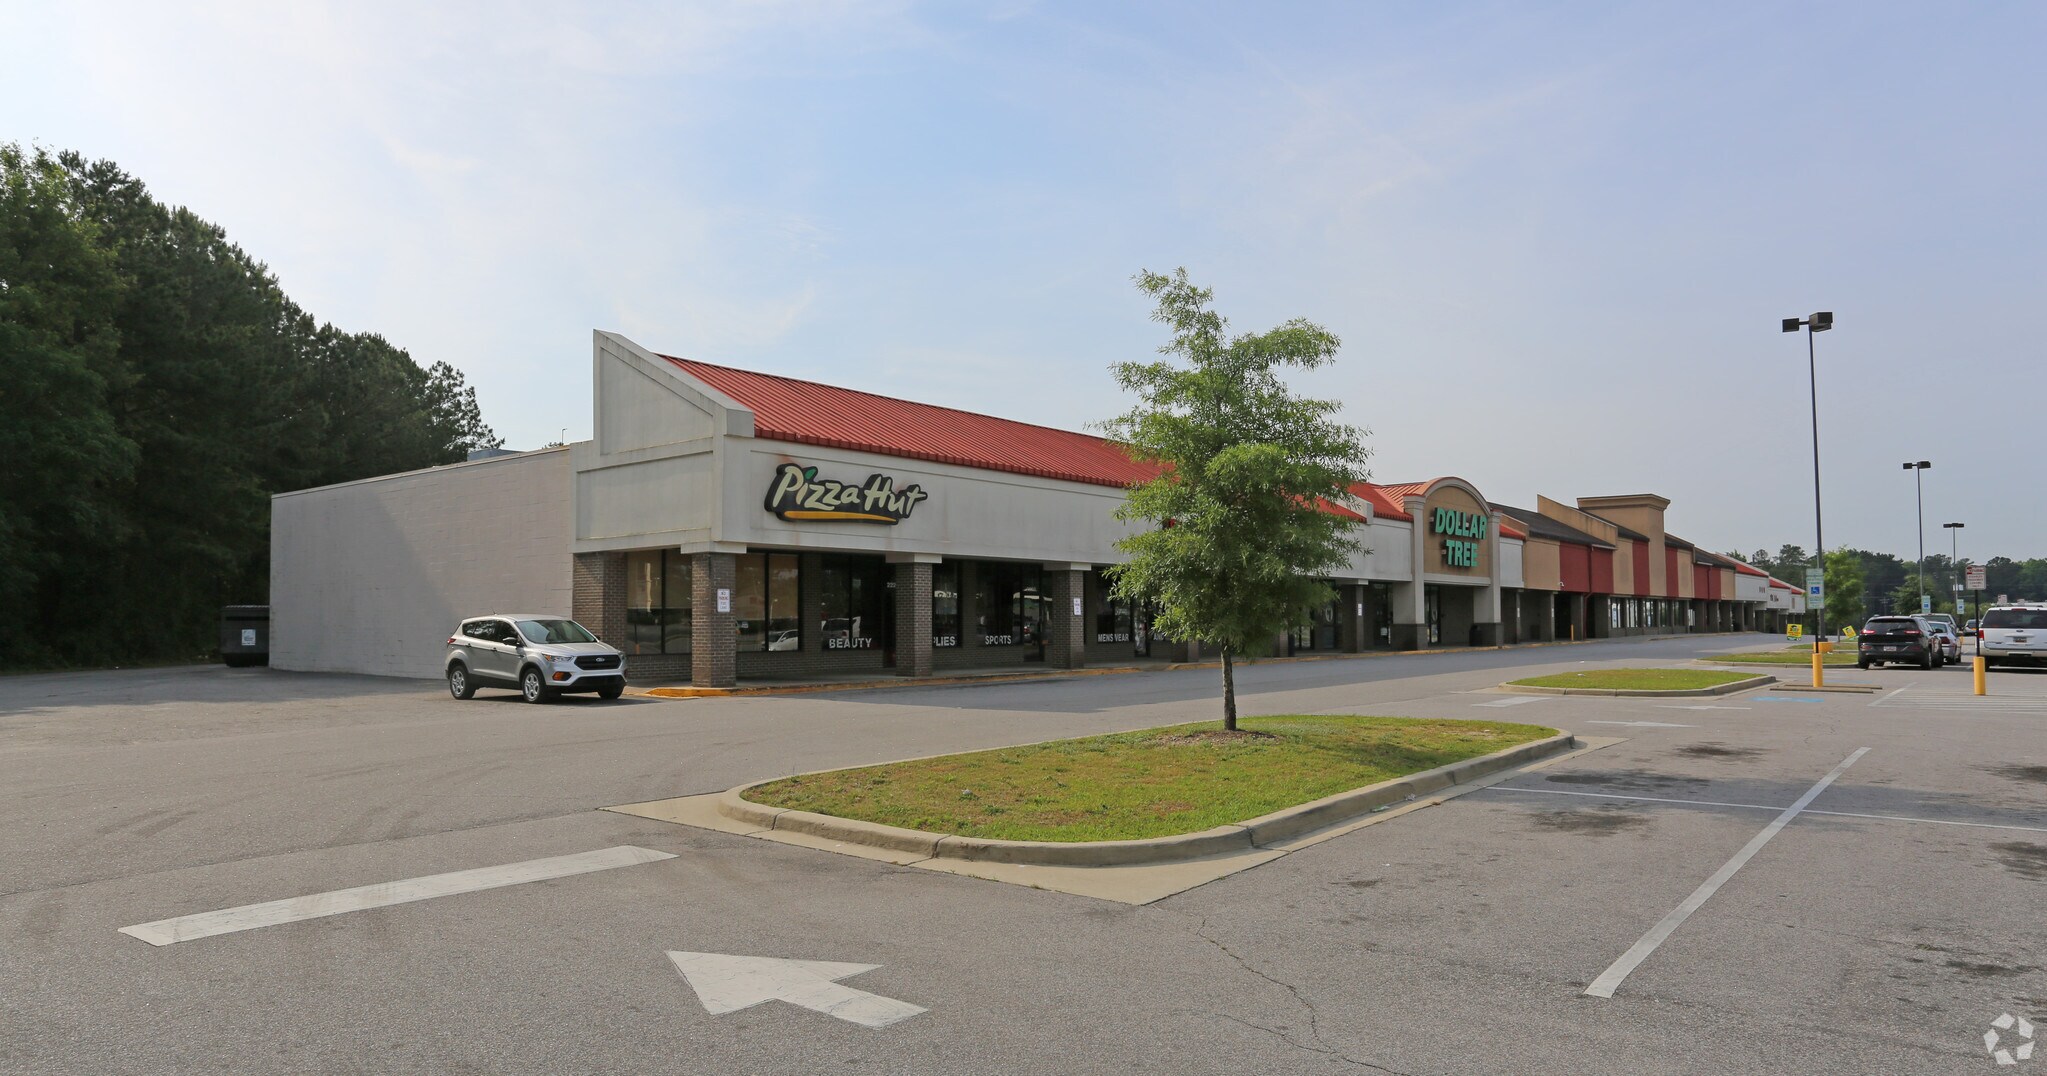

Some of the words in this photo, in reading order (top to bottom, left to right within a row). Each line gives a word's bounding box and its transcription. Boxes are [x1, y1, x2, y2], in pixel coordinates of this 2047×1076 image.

[773, 465, 860, 511] Pizza
[864, 476, 926, 515] Hut
[1435, 507, 1487, 539] DOLLAR
[1446, 539, 1478, 567] TREE
[828, 638, 872, 648] BEAUTY
[985, 635, 1012, 645] SPORTS
[1098, 633, 1113, 642] MENS
